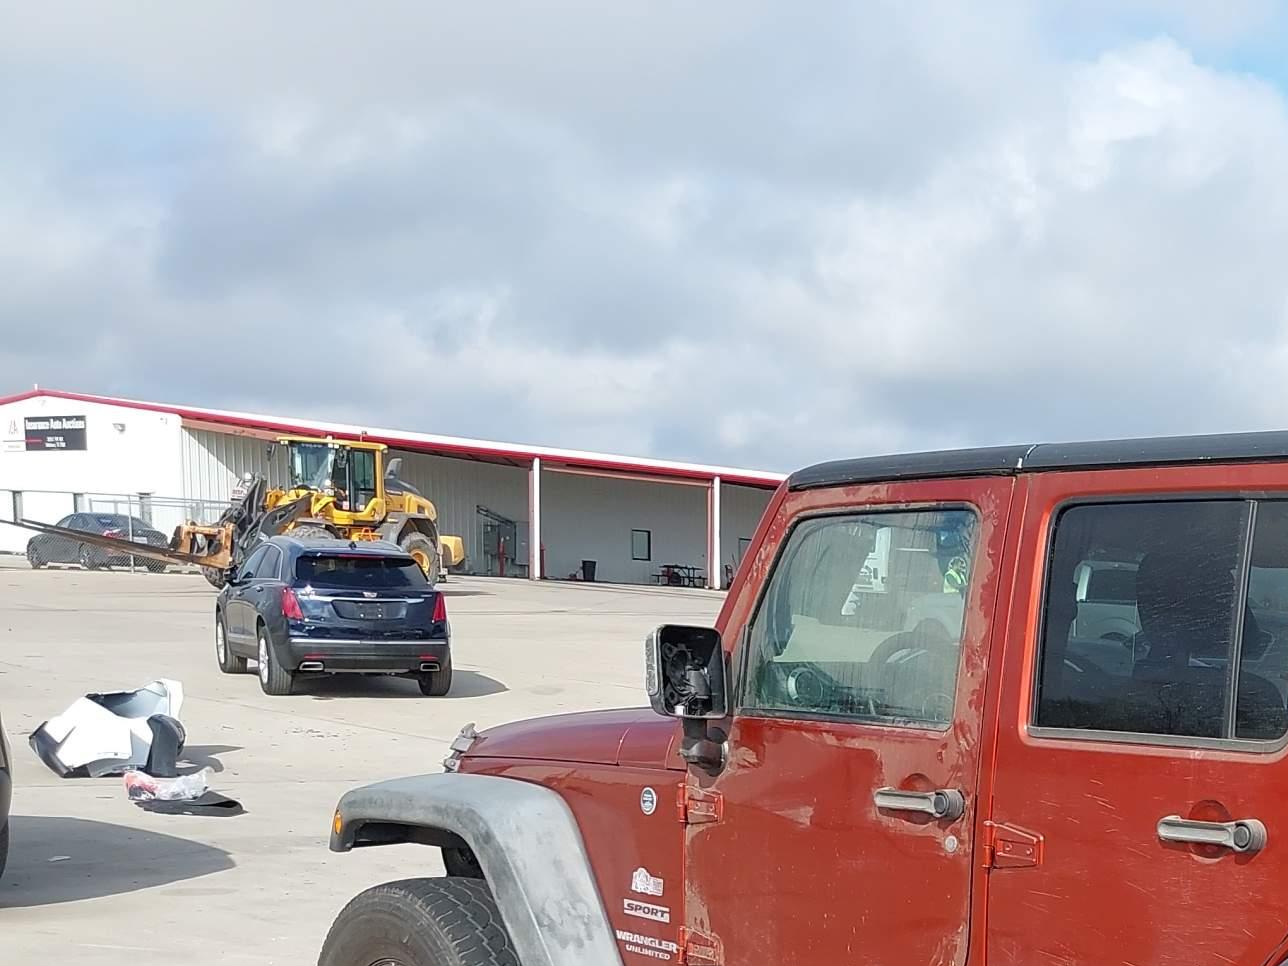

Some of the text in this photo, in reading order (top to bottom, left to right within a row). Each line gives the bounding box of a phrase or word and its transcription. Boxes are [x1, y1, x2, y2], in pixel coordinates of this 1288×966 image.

[626, 902, 668, 918] SPORT
[616, 929, 678, 953] WRANGLER
[626, 944, 670, 960] UNLIMITED
